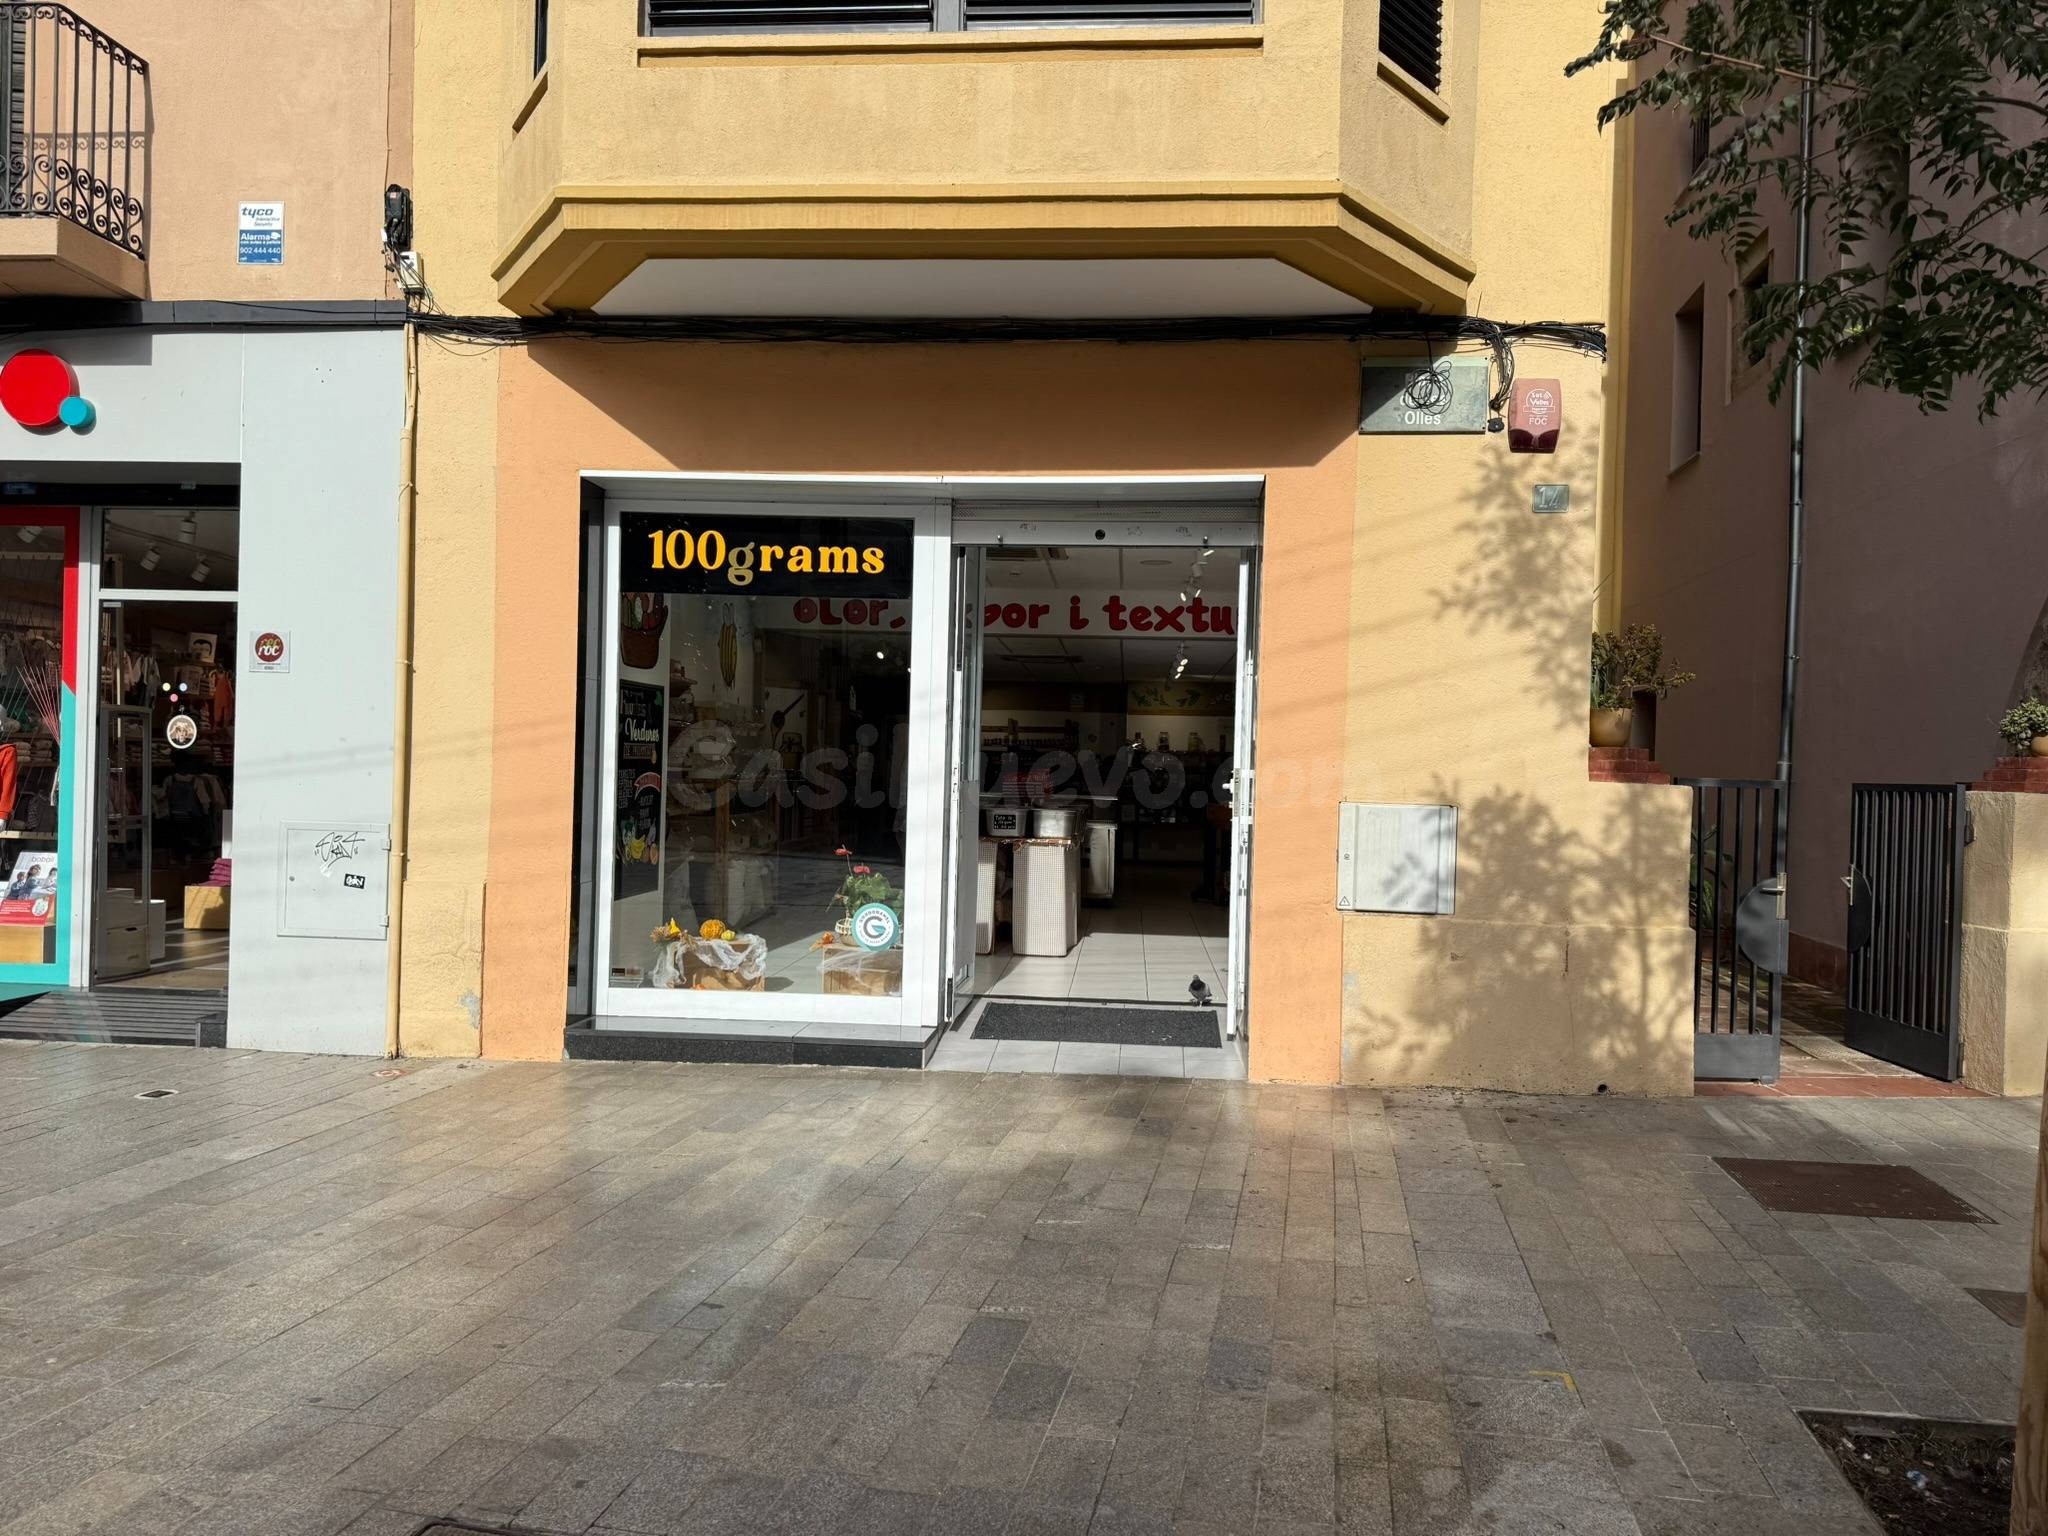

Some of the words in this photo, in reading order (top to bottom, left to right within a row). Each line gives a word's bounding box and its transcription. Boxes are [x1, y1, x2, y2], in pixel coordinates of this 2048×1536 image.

[241, 206, 273, 218] tyco
[241, 232, 271, 240] Alarma
[1404, 410, 1442, 425] Olles
[648, 529, 885, 586] 100grams
[1069, 595, 1089, 630] i
[1102, 595, 1239, 635] textu
